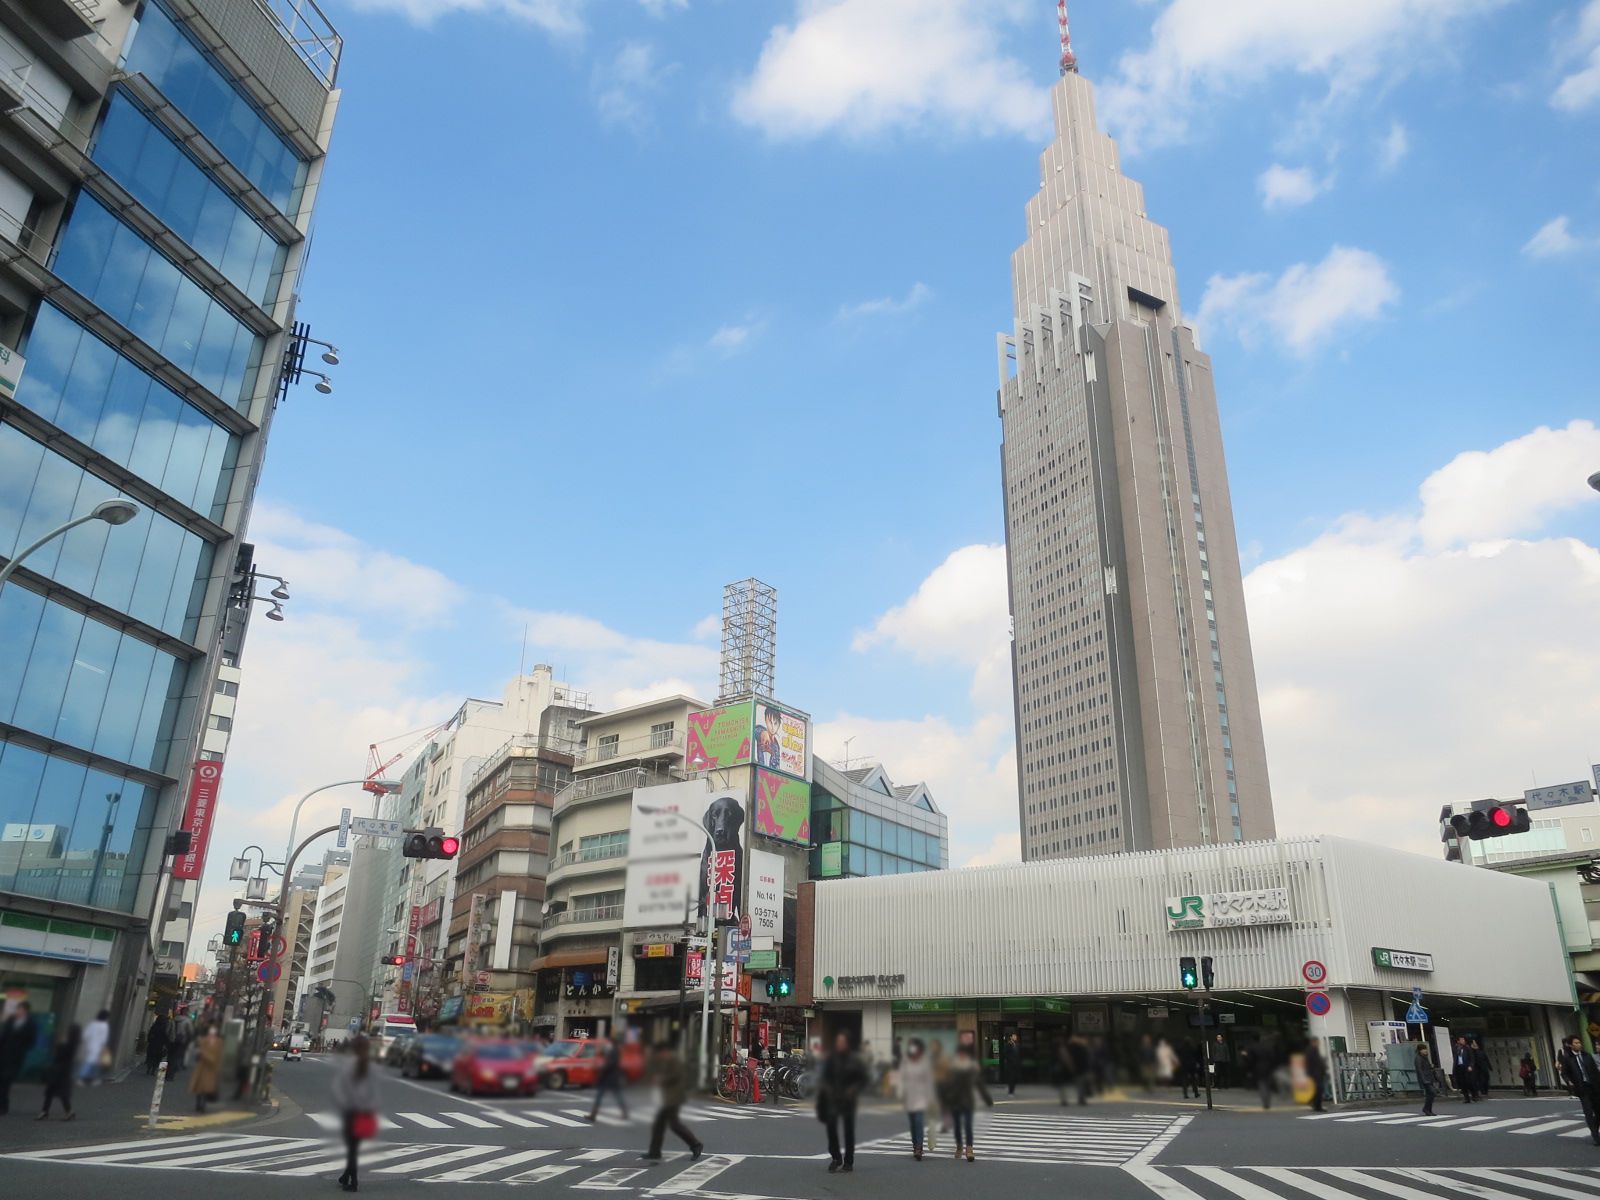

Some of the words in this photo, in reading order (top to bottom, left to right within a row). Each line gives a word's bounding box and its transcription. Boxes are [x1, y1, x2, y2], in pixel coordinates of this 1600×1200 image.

[183, 788, 209, 873] 三菱東京UFJ銀行
[756, 890, 776, 901] No.141
[1168, 895, 1205, 919] JR
[1209, 890, 1288, 916] 代々木駅
[755, 907, 778, 919] 03-5774
[1211, 916, 1246, 927] Yoyogi
[1250, 913, 1290, 924] Station
[759, 917, 774, 928] 7505
[608, 950, 617, 977] そば処
[1379, 952, 1390, 962] JR
[1392, 953, 1417, 967] 代々木駅
[1307, 967, 1322, 978] 30
